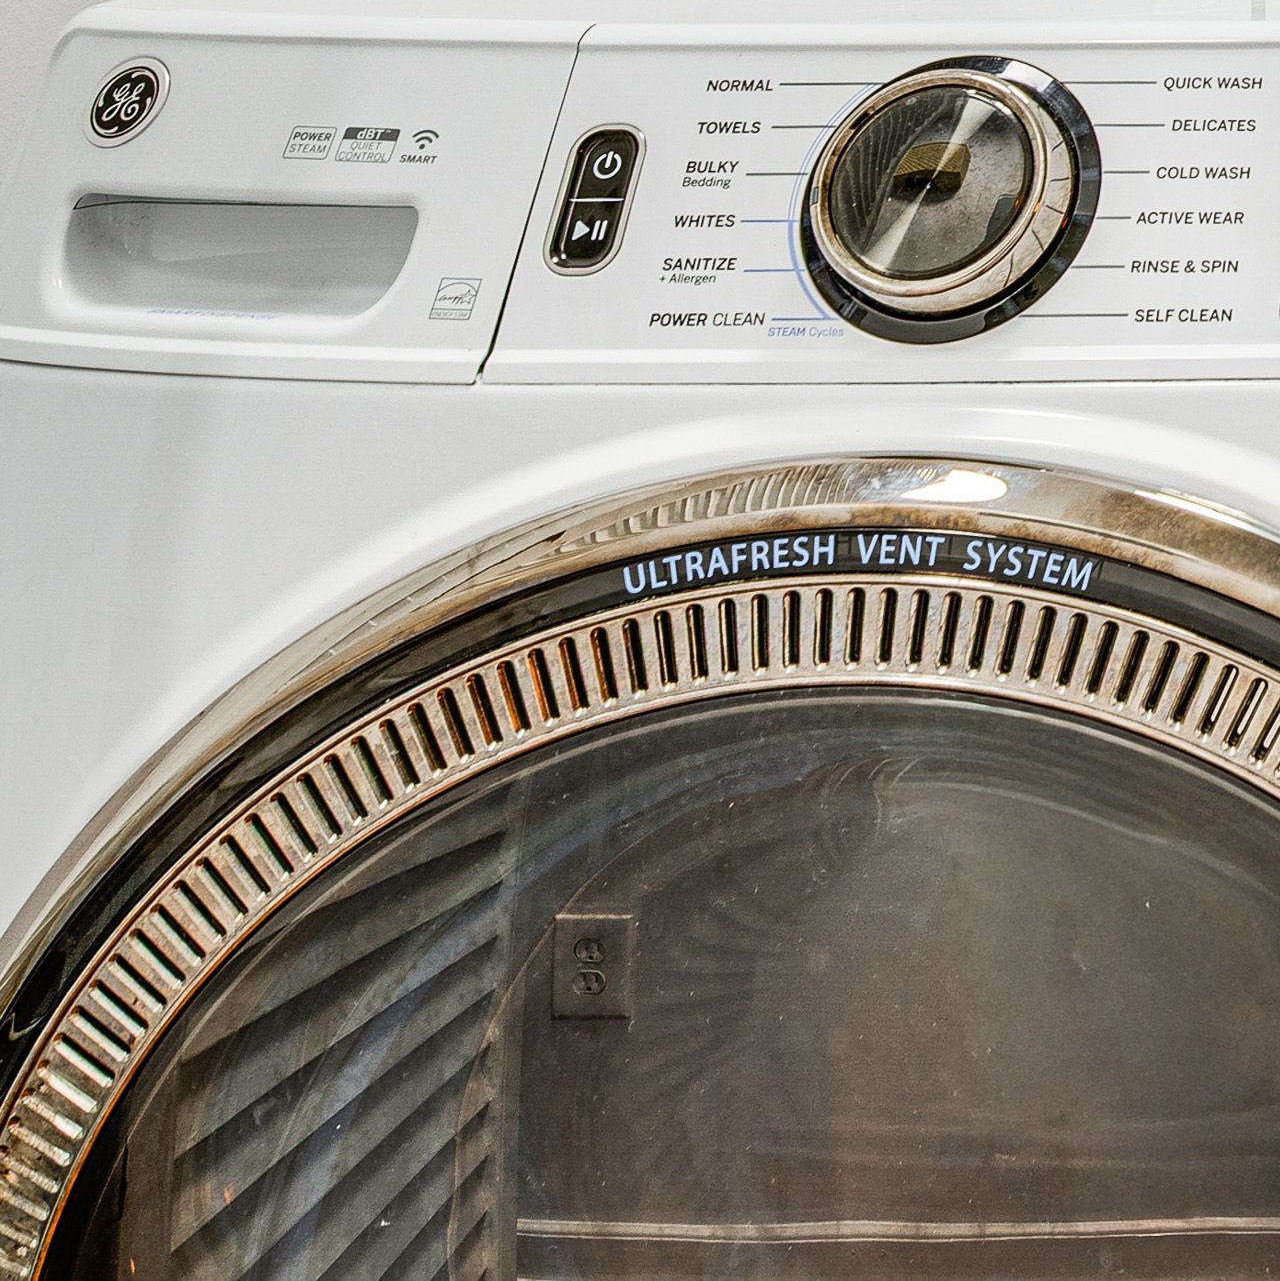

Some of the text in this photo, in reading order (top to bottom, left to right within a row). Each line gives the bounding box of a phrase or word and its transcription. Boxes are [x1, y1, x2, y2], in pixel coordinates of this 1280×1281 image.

[706, 79, 774, 92] NORMAL
[1163, 77, 1263, 92] QUICK WASH
[101, 82, 146, 121] GE
[697, 121, 761, 134] TOWELS
[1172, 119, 1256, 131] DELICATES
[293, 132, 332, 141] POWER
[289, 144, 327, 153] STEAM
[351, 142, 381, 150] QUIET
[337, 152, 386, 161] CONTROL
[400, 155, 437, 164] SMART
[685, 161, 739, 173] BULKY
[1156, 167, 1251, 179] COLD WASH
[682, 177, 731, 189] Bedding
[673, 215, 736, 228] WHITES
[1136, 211, 1244, 225] ACTIVE WEAR
[662, 258, 737, 271] SANITIZE
[1130, 260, 1239, 273] RINSE & SPIN
[669, 273, 716, 285] Allergen
[649, 313, 766, 326] POWER CLEAN
[1134, 309, 1233, 322] SELF CLEAN
[767, 327, 844, 339] STEAM Cycles
[622, 534, 1096, 594] ULTRAFRESH VENT SYSTEM
